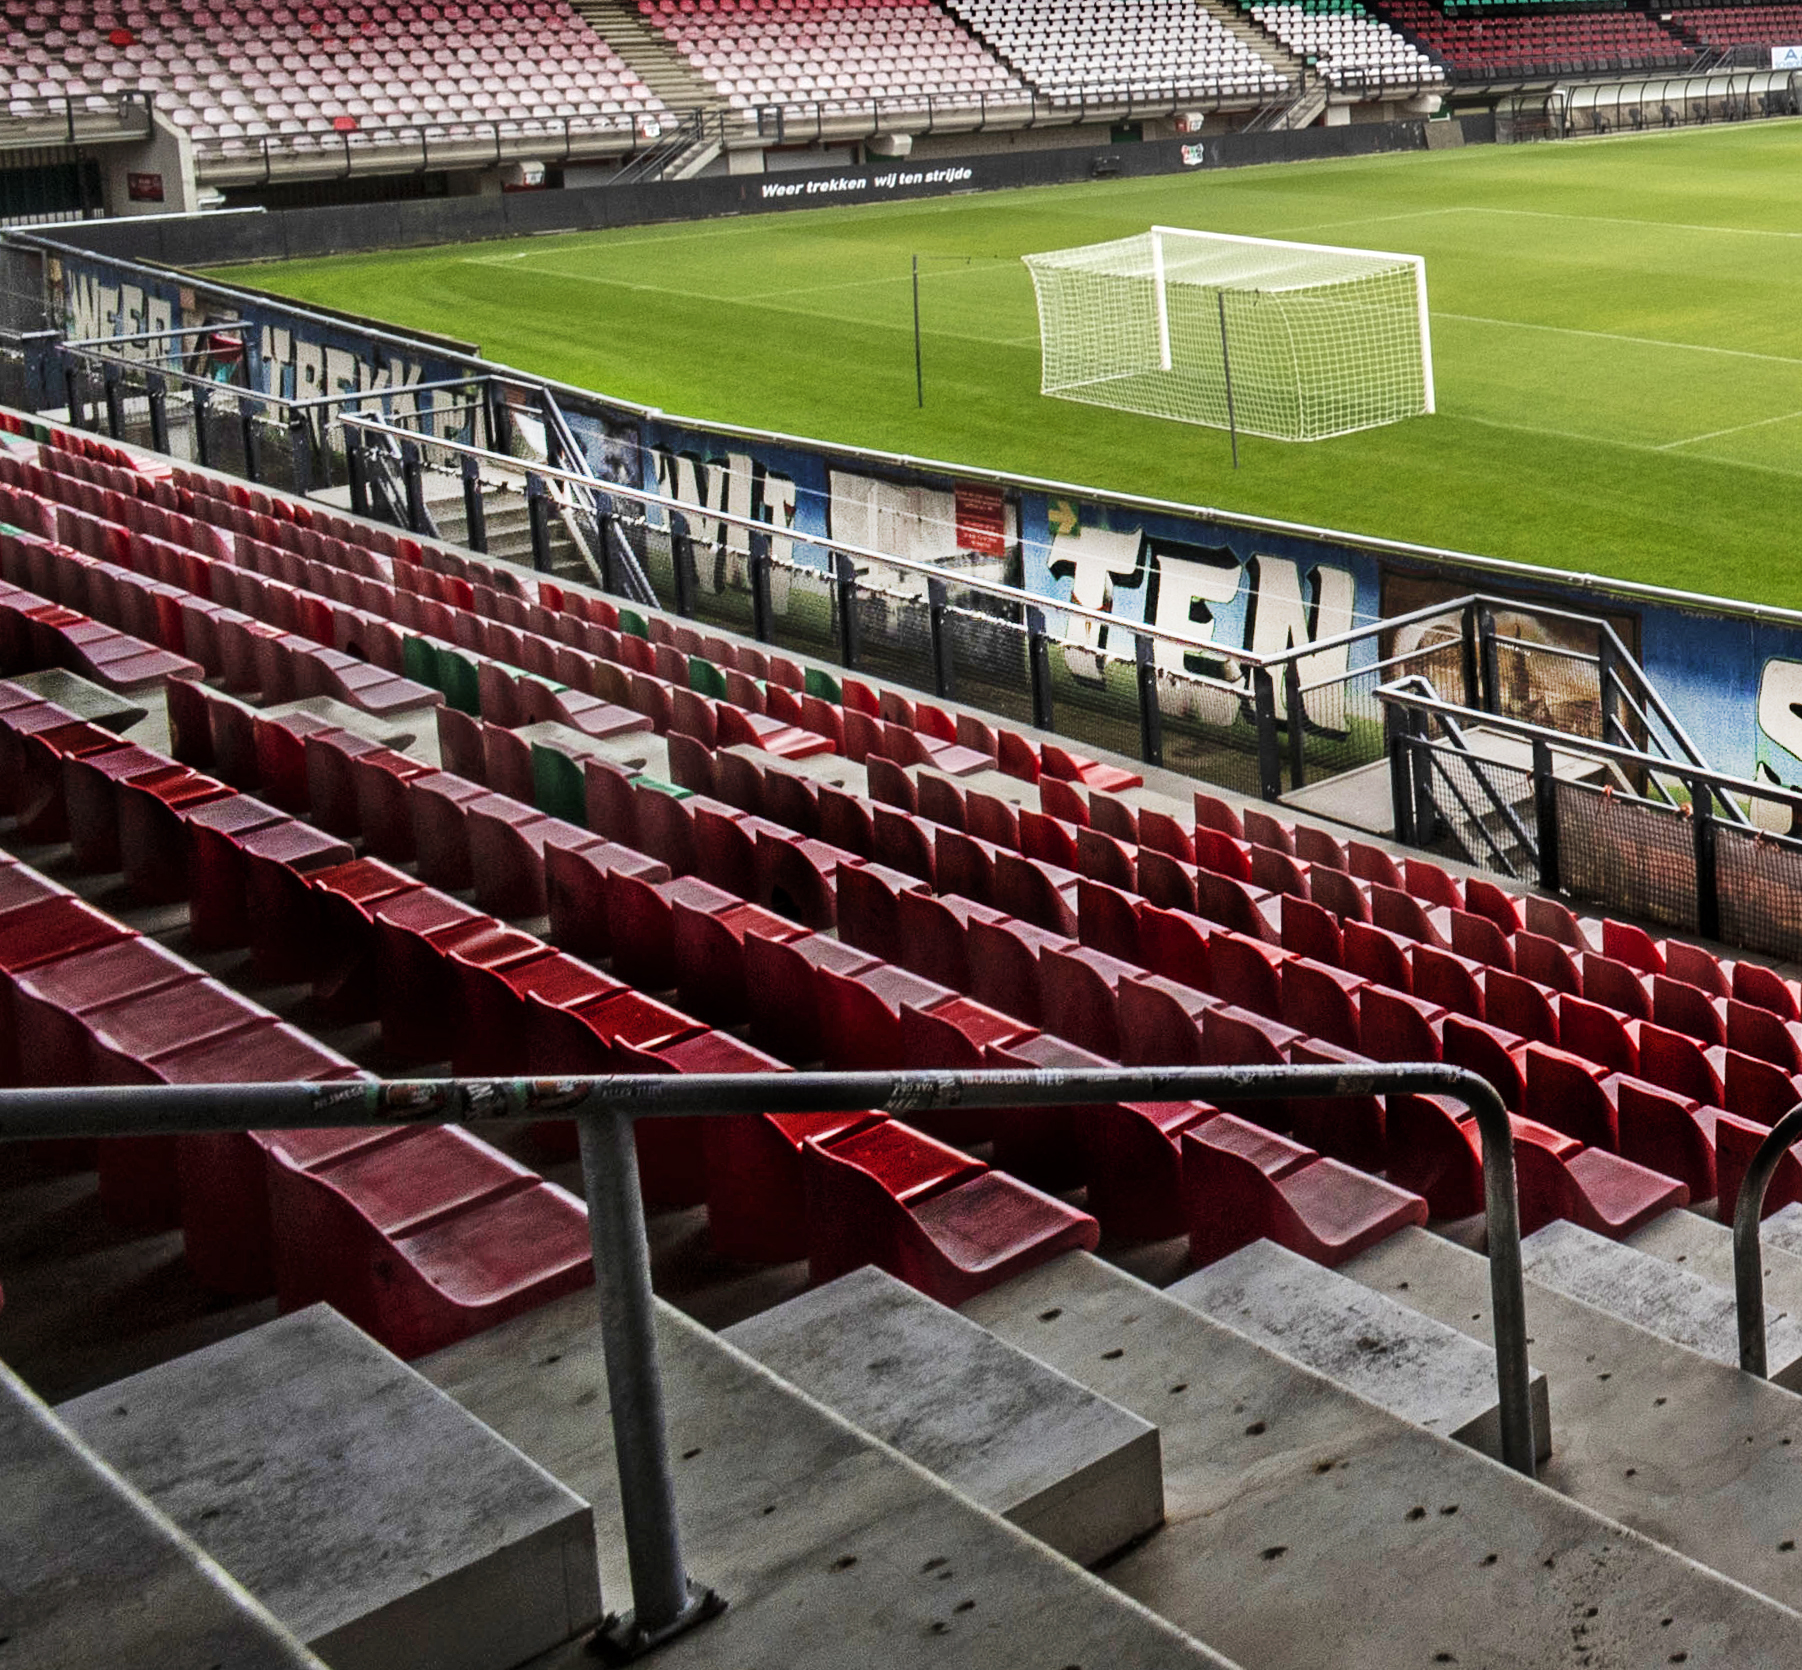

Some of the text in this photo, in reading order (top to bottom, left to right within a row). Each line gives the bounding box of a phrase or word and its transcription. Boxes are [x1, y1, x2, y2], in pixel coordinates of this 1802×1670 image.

[761, 166, 973, 199] Weer trekken wij ten strijde
[1046, 524, 1357, 733] TEN
